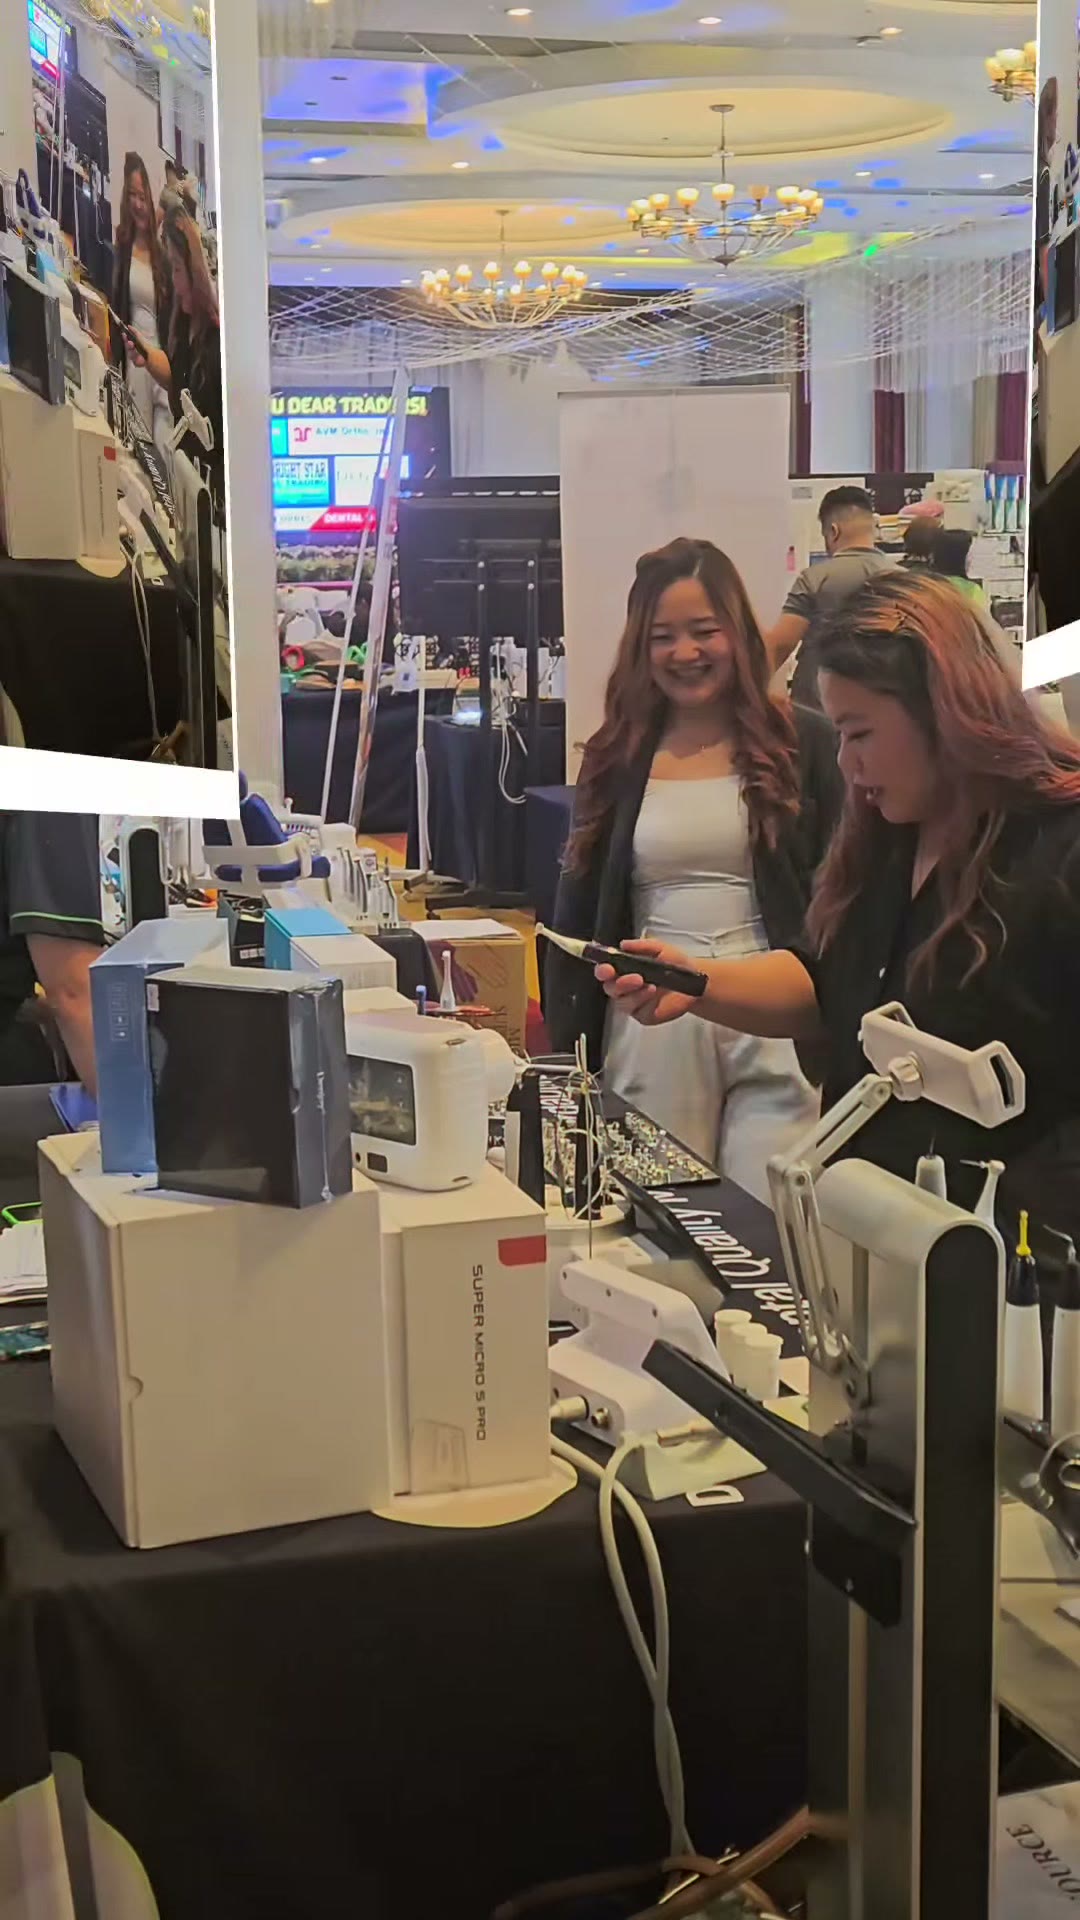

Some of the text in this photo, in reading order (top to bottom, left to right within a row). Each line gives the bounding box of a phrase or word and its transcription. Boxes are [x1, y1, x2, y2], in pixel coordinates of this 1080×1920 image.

[288, 396, 338, 415] DEAR
[472, 1263, 487, 1441] SUPER MICRO S PRO
[1006, 1823, 1080, 1902] OURCE
